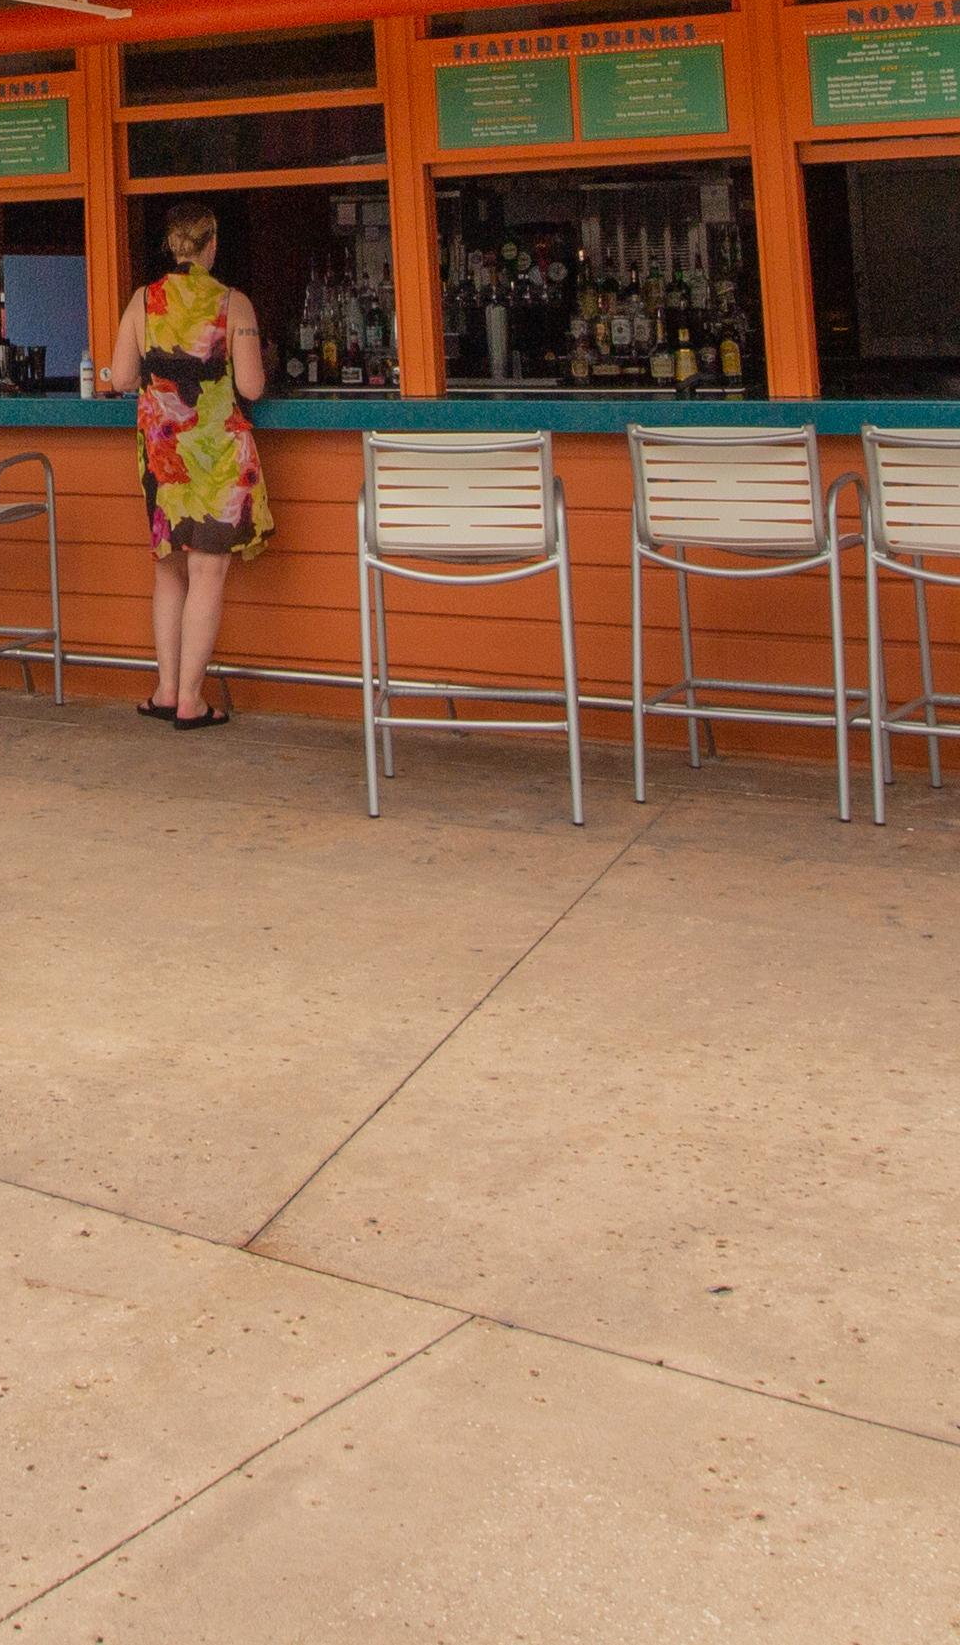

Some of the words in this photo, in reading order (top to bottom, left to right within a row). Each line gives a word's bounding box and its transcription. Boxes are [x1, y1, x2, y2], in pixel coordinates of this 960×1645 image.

[847, 4, 920, 24] NOW
[454, 34, 569, 60] FEATURE
[580, 23, 697, 49] DRINKS
